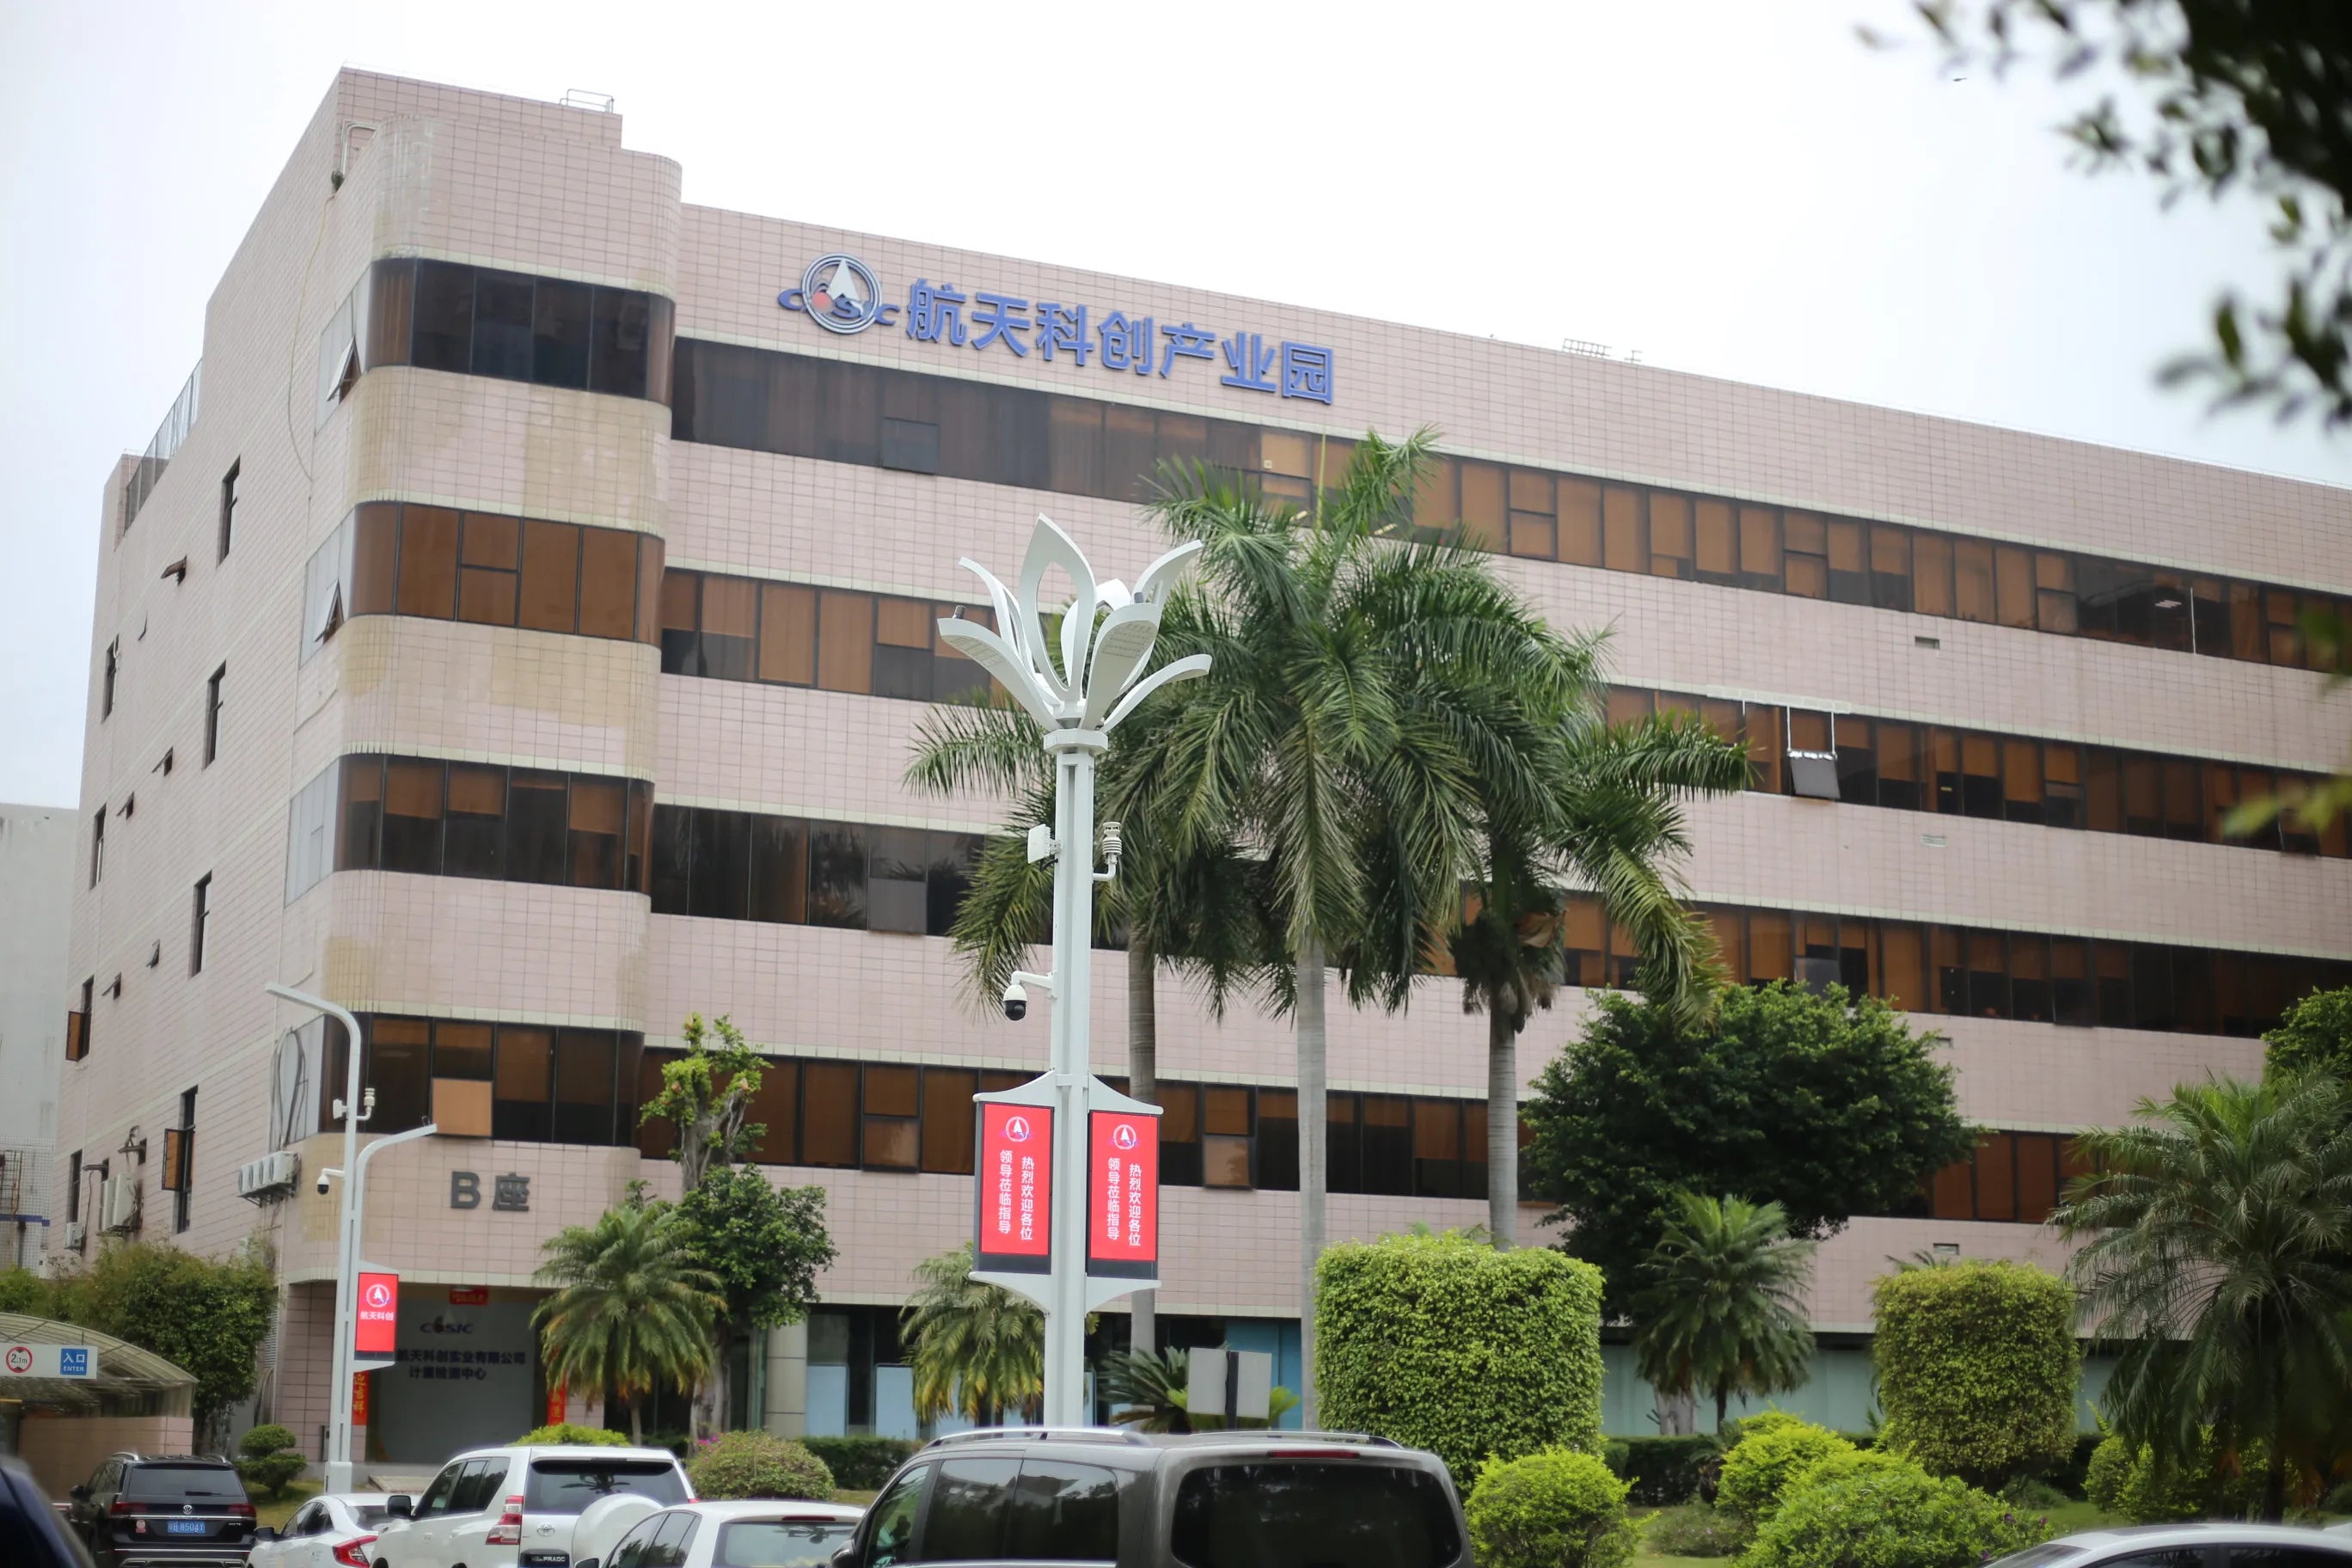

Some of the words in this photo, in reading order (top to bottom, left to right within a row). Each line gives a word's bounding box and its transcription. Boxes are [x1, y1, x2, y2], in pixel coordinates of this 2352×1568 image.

[906, 278, 1334, 405] 航天科创产业园
[998, 1149, 1013, 1234] 领导莅临指导
[1020, 1156, 1034, 1240] 热烈欢迎各位
[1107, 1157, 1120, 1240] 领导莅临指导
[1129, 1163, 1142, 1246] 热烈欢迎各位
[360, 1311, 394, 1320] 航天科创
[63, 1353, 85, 1363] 入口
